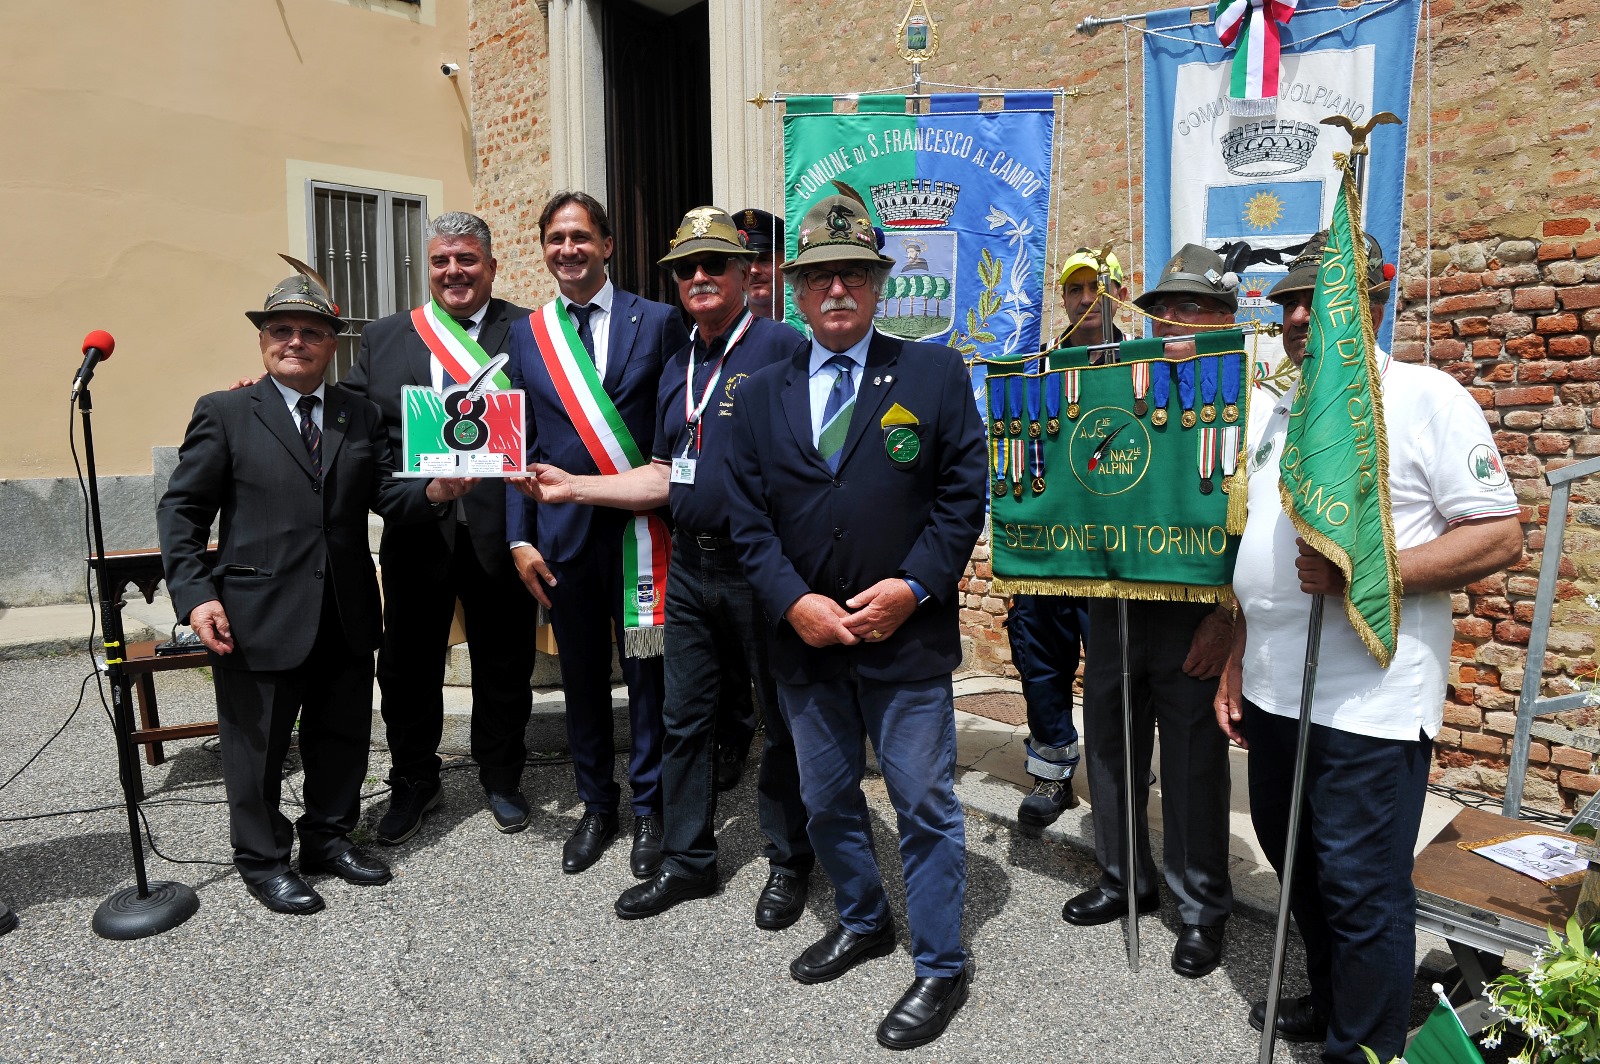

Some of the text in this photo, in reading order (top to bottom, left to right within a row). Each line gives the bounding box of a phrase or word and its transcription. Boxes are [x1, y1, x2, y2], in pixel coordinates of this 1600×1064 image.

[1177, 94, 1230, 137] COMUN
[1279, 82, 1365, 122] VOLPIANO
[794, 146, 853, 200] COMUNE
[972, 148, 985, 168] AL
[990, 151, 1043, 198] CAMPO
[1337, 337, 1360, 366] DI
[1346, 376, 1374, 495] TORINO
[1097, 462, 1133, 475] ALPINI
[1005, 524, 1227, 556] SEZIONE DI TORINO
